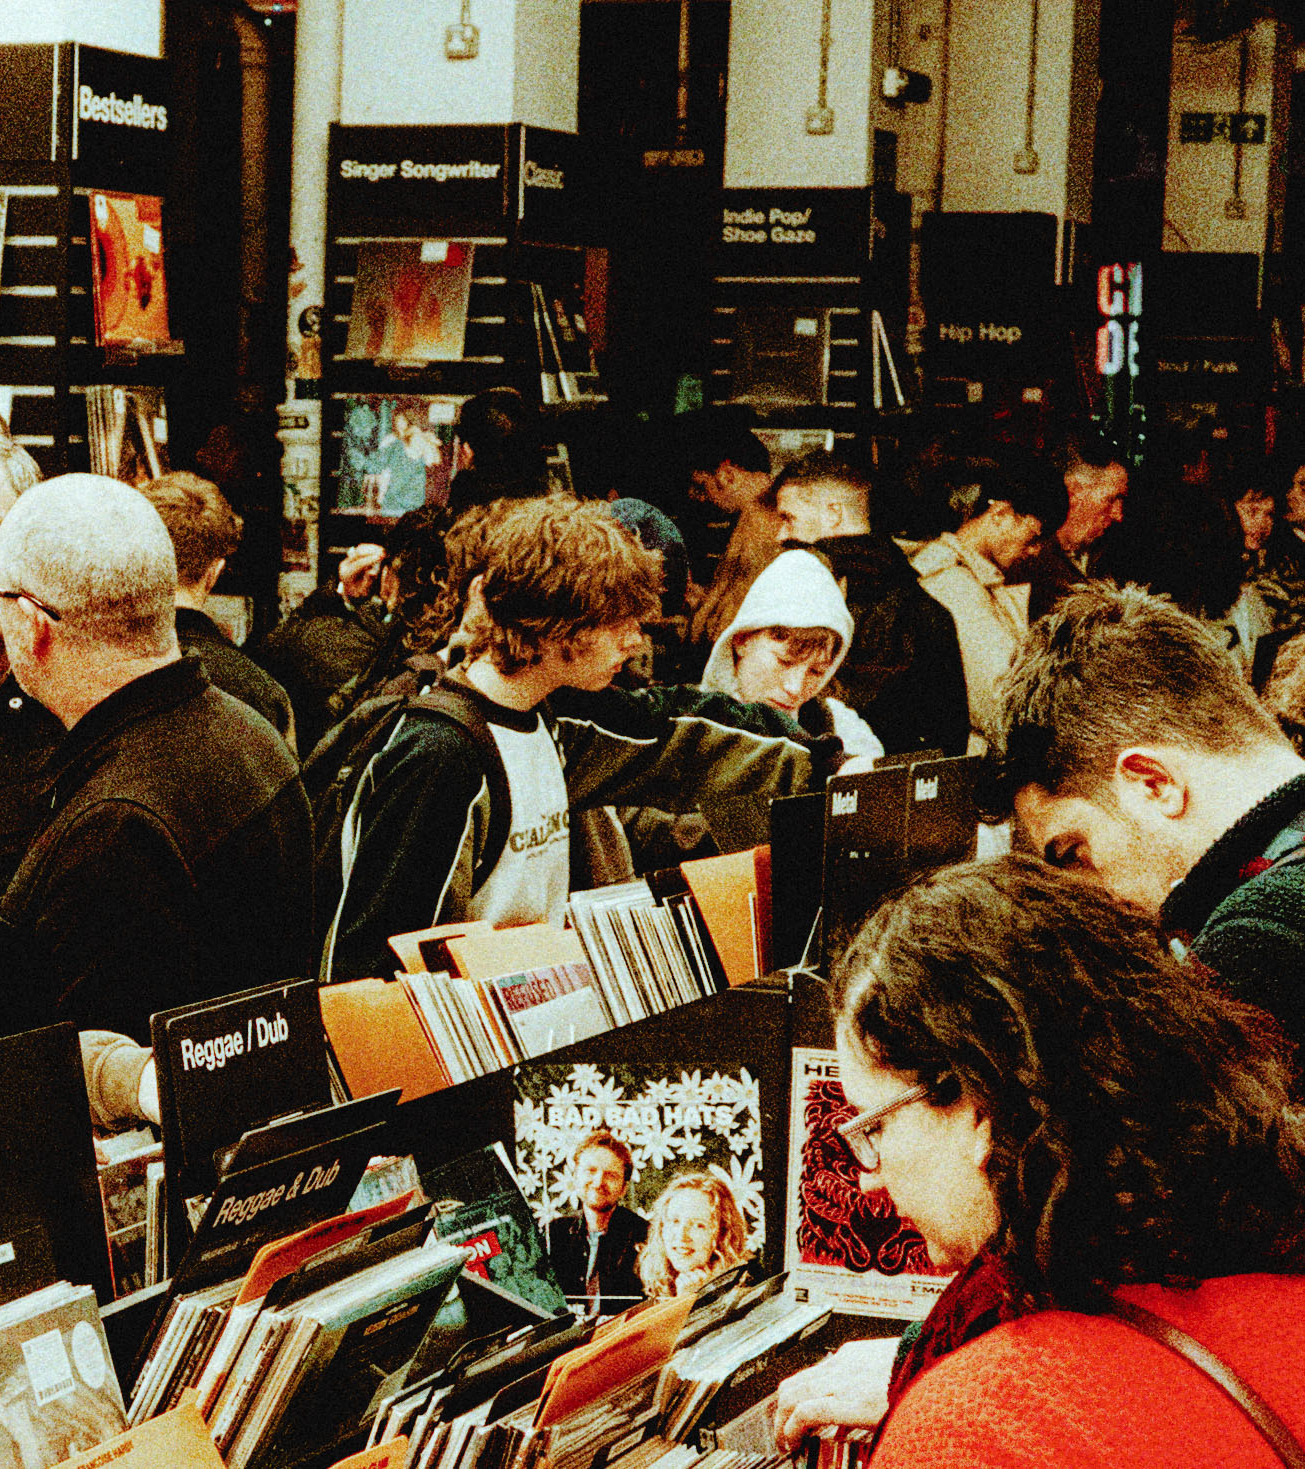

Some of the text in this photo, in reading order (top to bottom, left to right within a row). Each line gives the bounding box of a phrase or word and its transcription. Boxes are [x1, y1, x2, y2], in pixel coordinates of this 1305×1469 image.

[79, 84, 168, 131] Bestsellers
[340, 159, 501, 182] Singer Songwriter
[722, 208, 813, 227] Indie Pop/
[722, 226, 816, 244] Shoe Gaze
[939, 322, 1022, 345] Hip Hop
[832, 789, 858, 816] Metal
[180, 1012, 289, 1071] Reggae / Dub
[548, 1103, 737, 1128] BAD BAD HATS
[212, 1184, 286, 1229] Reggae
[285, 1171, 305, 1201] &
[301, 1158, 341, 1196] Dub
